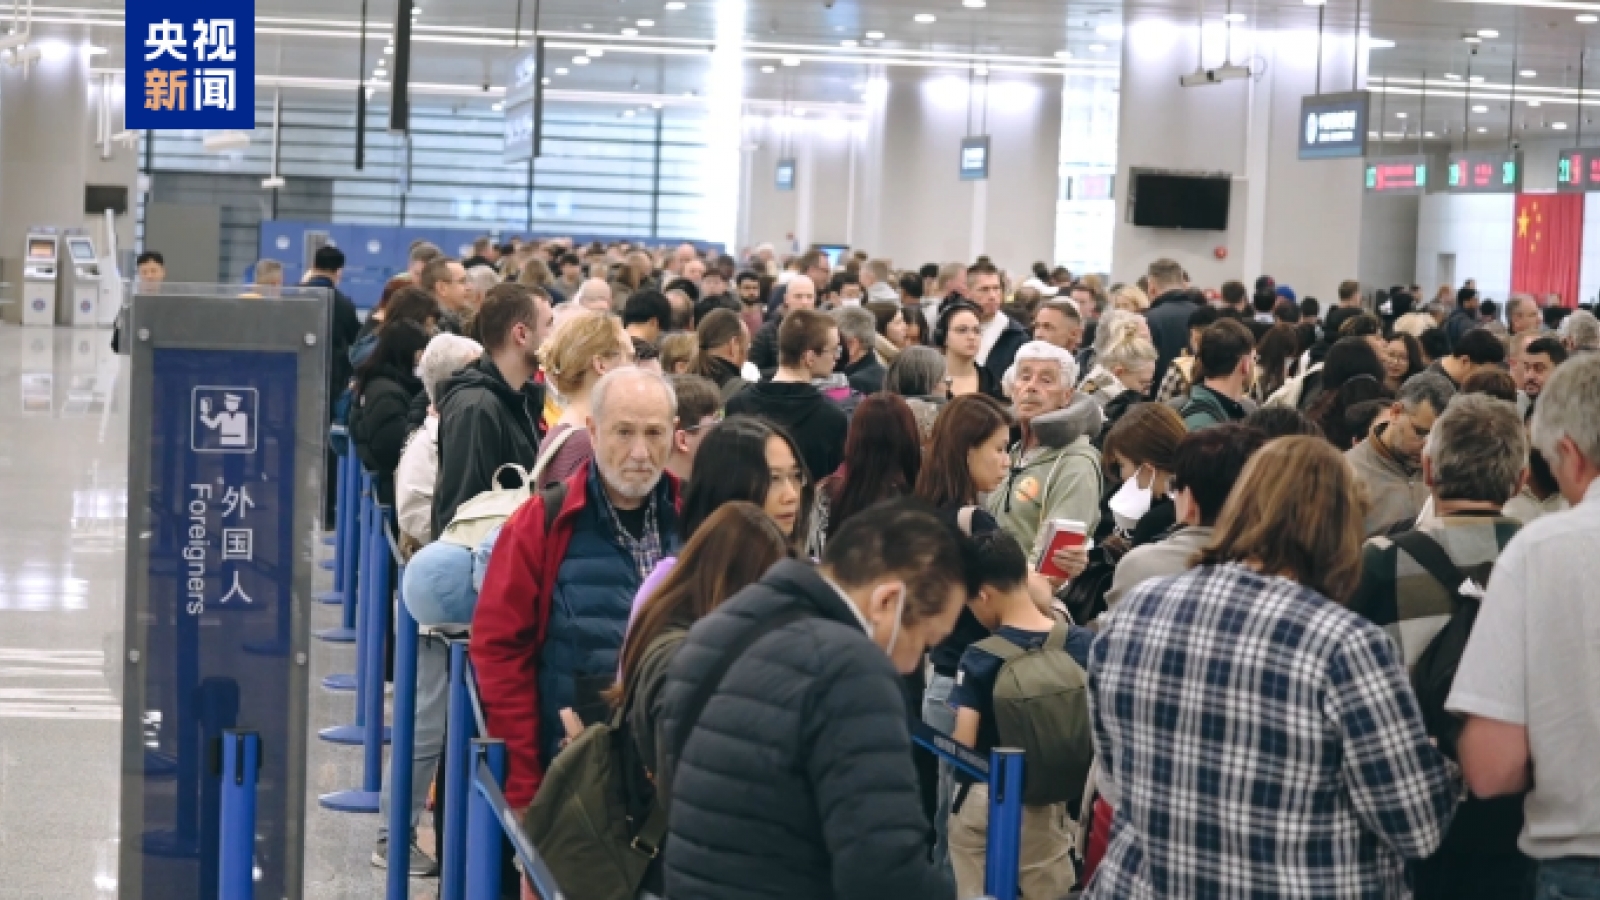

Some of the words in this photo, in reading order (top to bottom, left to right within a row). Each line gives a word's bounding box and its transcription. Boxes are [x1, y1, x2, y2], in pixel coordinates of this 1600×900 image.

[182, 483, 212, 615] Foreigners
[220, 485, 255, 603] 外国人
